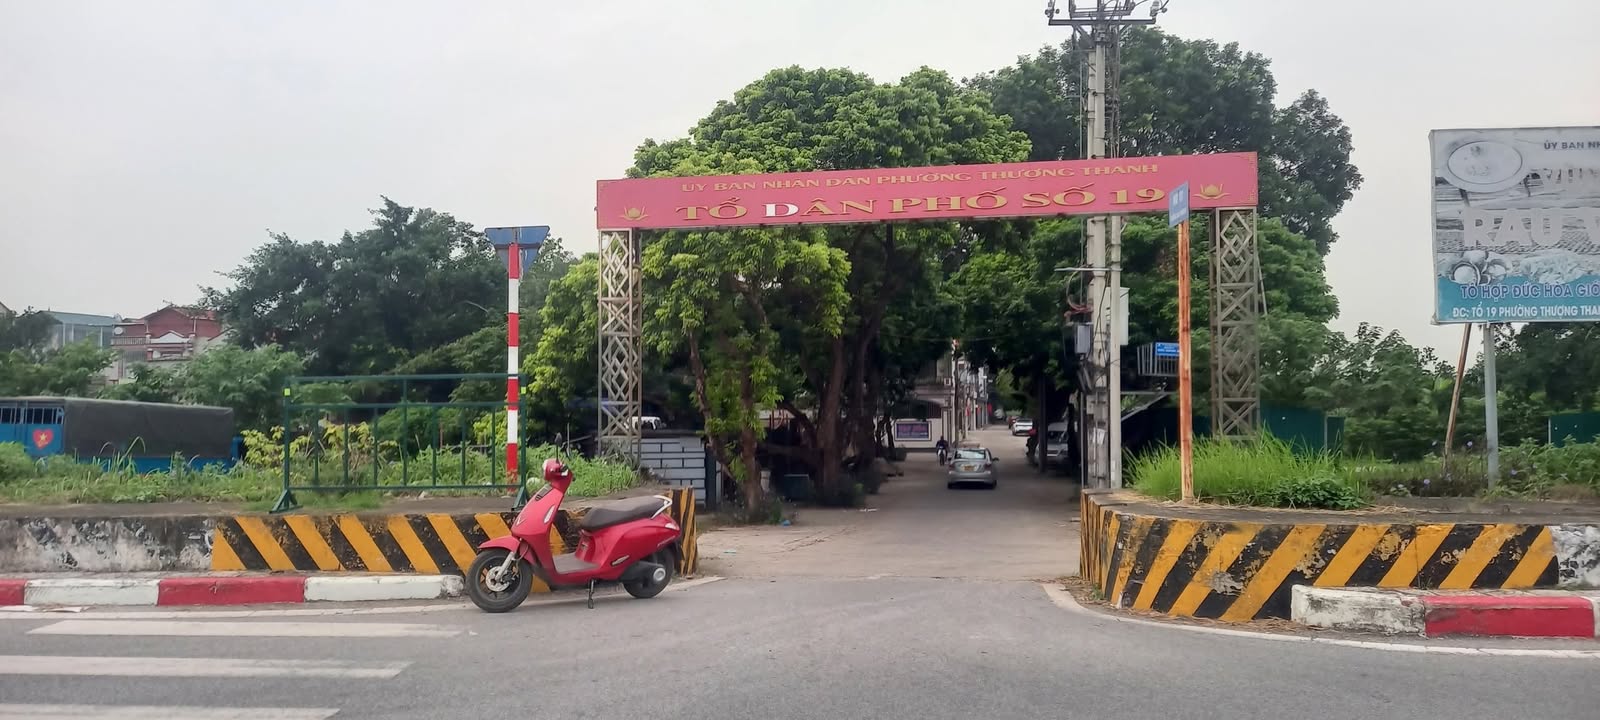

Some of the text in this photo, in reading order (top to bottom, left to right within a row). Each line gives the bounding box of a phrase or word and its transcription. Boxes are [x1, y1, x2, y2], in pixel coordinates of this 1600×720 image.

[1562, 141, 1584, 149] BAN
[714, 182, 756, 191] BAN
[1081, 164, 1158, 176] THANH
[676, 196, 747, 220] TỔ
[762, 198, 876, 218] DÂN
[888, 187, 1008, 213] PHỐ
[1022, 183, 1096, 208] SỐ
[1110, 187, 1165, 205] 19
[1481, 284, 1508, 302] HỢP
[1512, 281, 1540, 298] ĐỨC
[1453, 307, 1469, 317] ĐC:
[1472, 301, 1483, 317] TỔ
[1487, 307, 1497, 316] 19
[1499, 304, 1537, 317] PHƯỜNG
